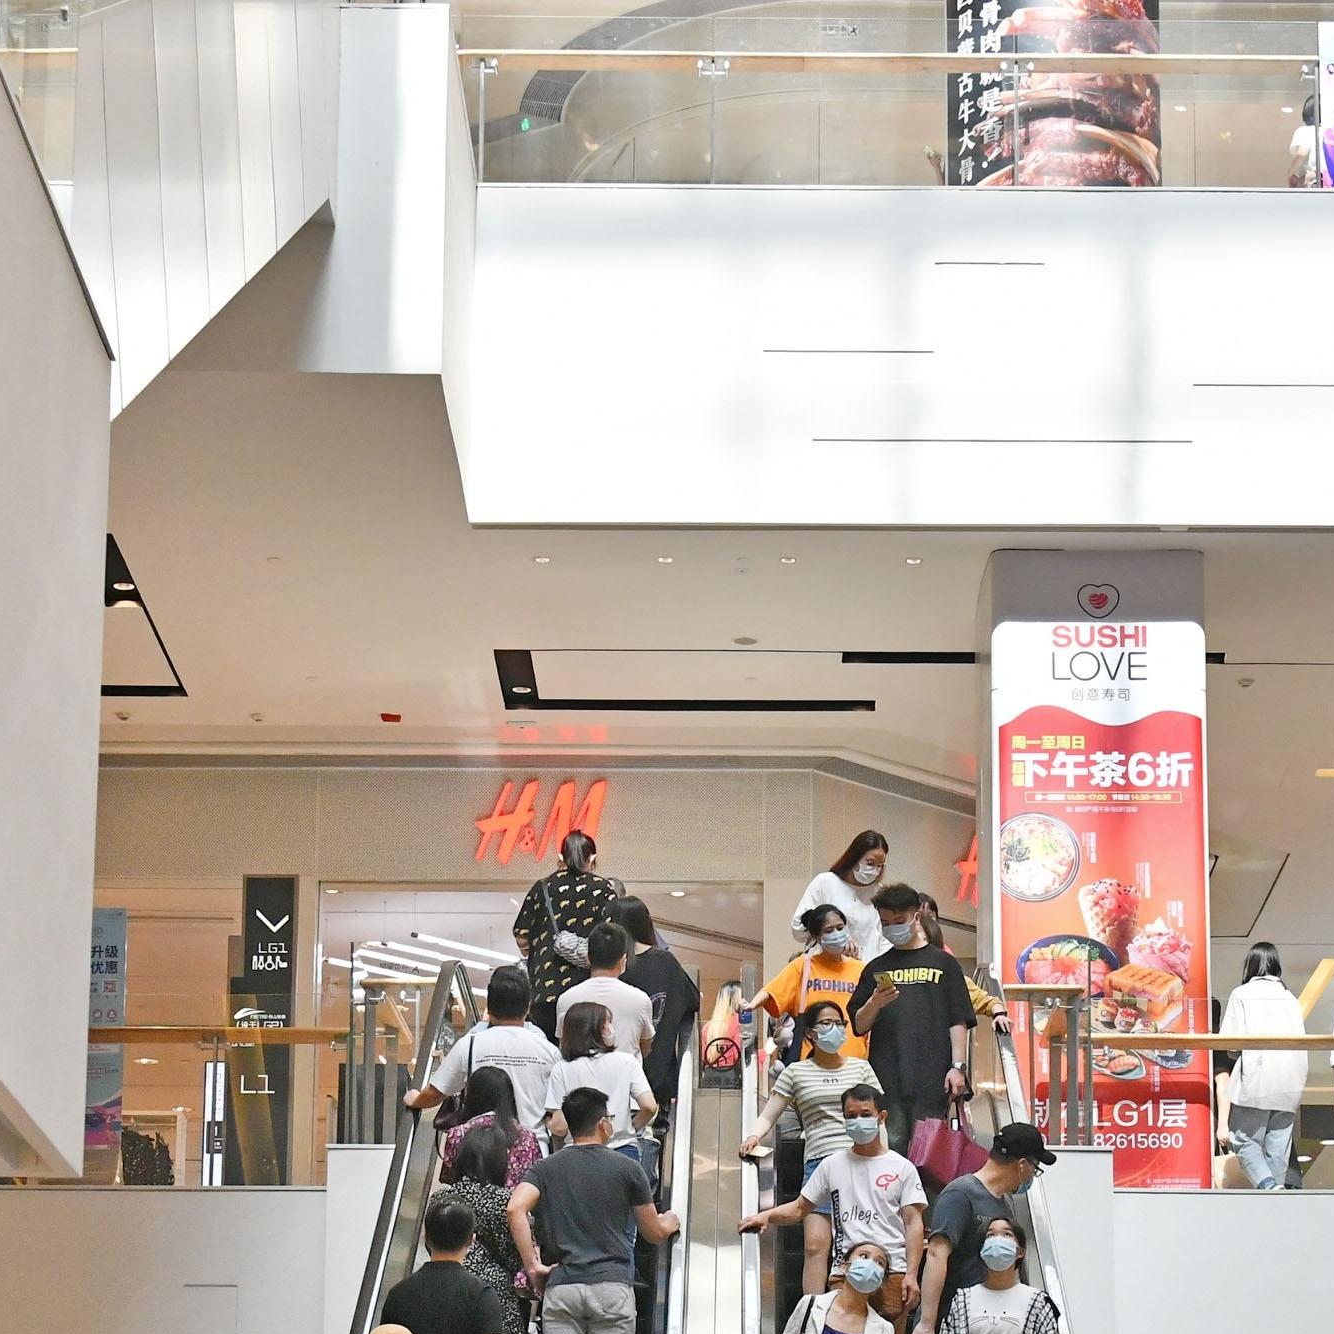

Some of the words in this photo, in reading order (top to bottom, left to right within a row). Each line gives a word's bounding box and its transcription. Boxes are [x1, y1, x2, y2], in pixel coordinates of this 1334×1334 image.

[1052, 625, 1147, 647] SUSHI
[1052, 651, 1147, 681] LOVE
[1071, 688, 1130, 701] 创意寿司
[1011, 736, 1085, 749] 周一至周日
[1011, 751, 1194, 788] 下午茶6折
[475, 779, 610, 865] H&M
[258, 943, 288, 954] LG1
[91, 961, 118, 974] 优惠
[886, 967, 944, 984] ROHIBIT
[807, 978, 857, 993] PROHIB
[240, 1074, 275, 1093] L1
[1093, 1132, 1183, 1149] 82615690
